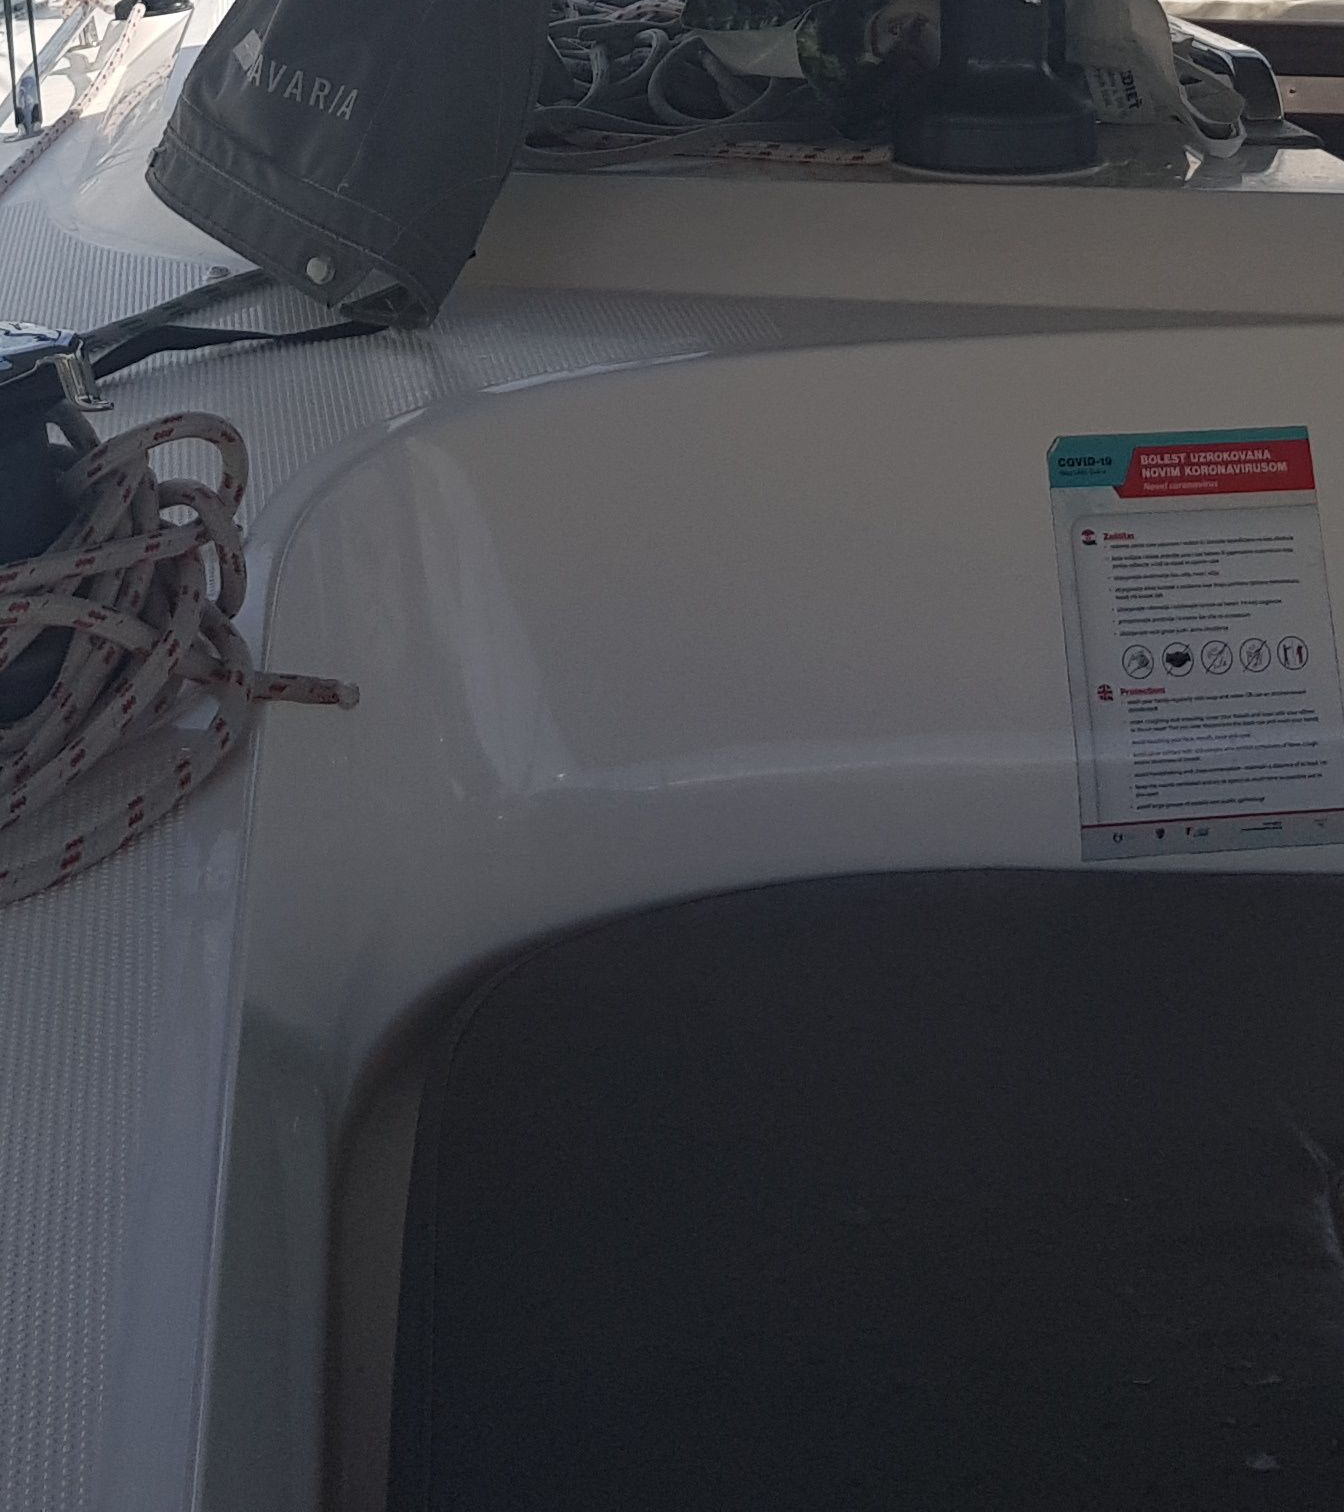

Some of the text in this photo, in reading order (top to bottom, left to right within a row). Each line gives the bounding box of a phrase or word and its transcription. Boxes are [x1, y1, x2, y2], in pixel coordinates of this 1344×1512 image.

[246, 53, 358, 121] AVARIA
[1058, 456, 1113, 468] COVID-19
[1140, 449, 1271, 465] BOLEST UZROKOVANA
[1141, 461, 1288, 478] NOVIM KORONAVIRUSOM
